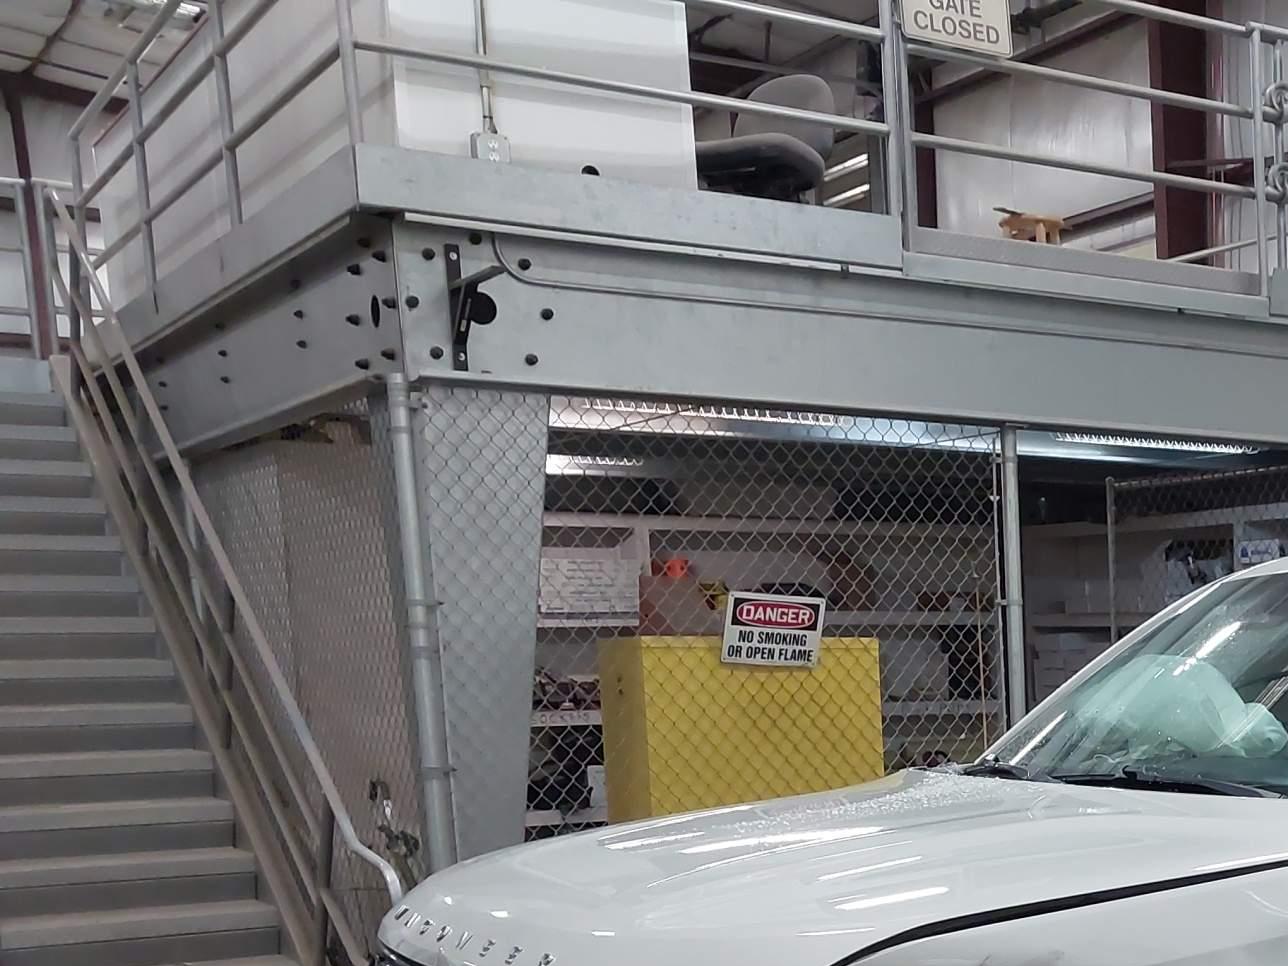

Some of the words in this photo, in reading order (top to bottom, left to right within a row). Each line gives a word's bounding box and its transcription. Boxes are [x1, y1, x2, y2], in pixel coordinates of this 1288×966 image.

[914, 10, 1000, 44] CLOSED
[742, 605, 810, 624] DANGER
[738, 630, 754, 643] NO
[757, 631, 807, 646] SMOKING
[727, 645, 742, 658] OR
[746, 646, 775, 660] OPEN
[778, 648, 813, 662] FLAME
